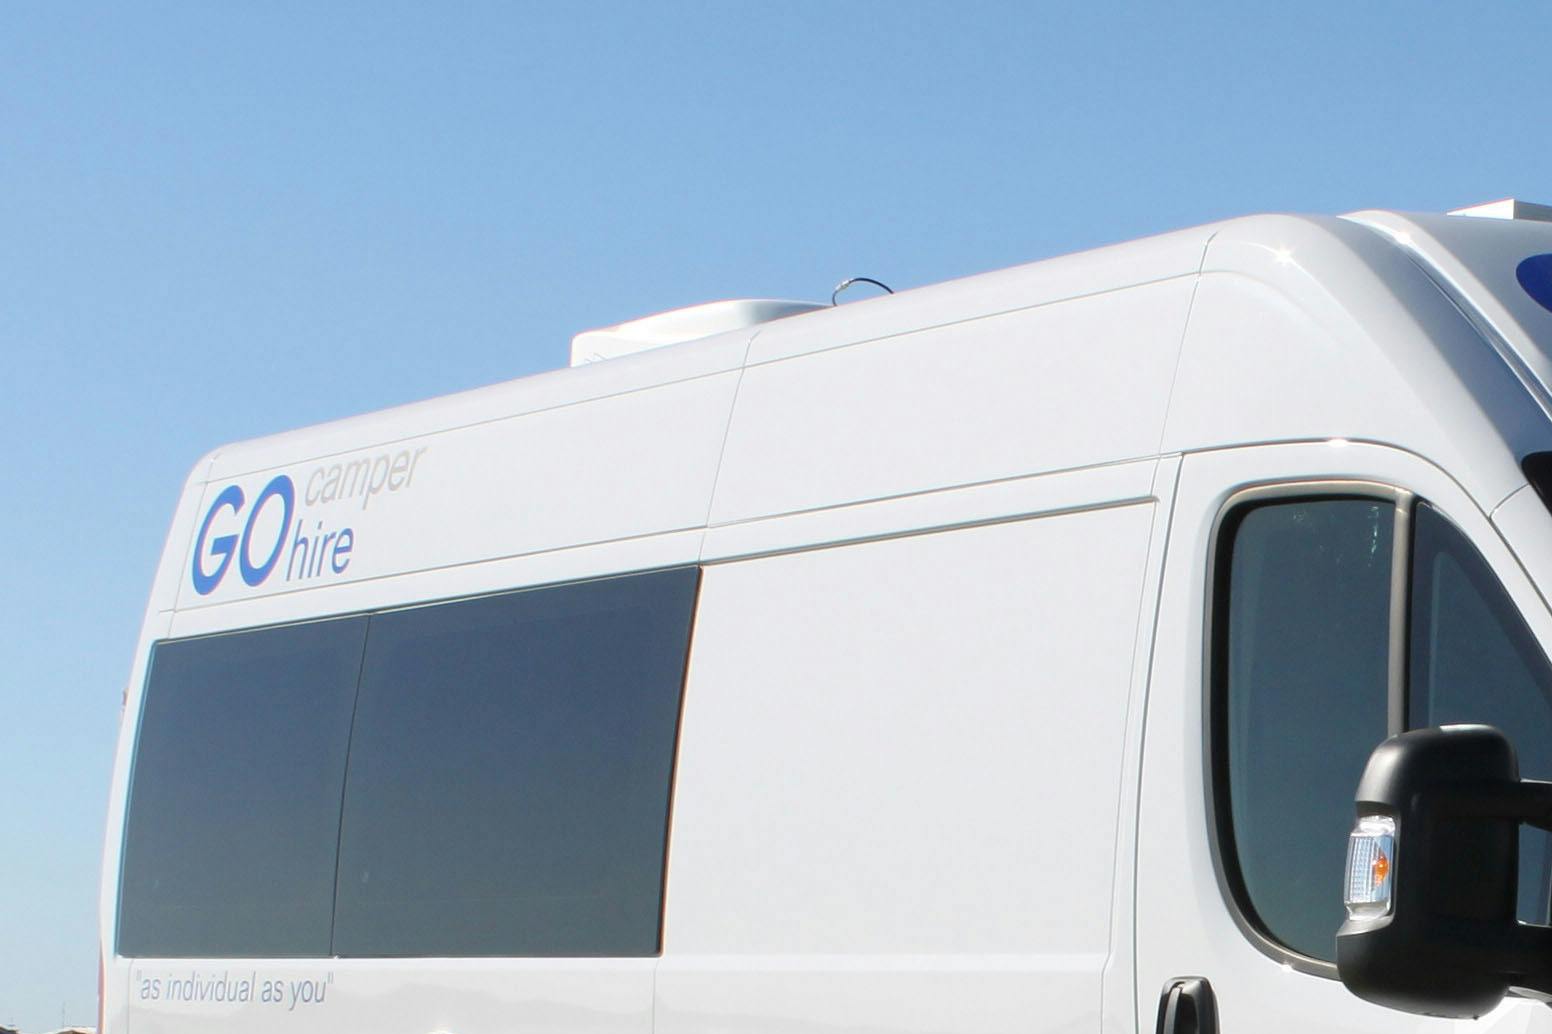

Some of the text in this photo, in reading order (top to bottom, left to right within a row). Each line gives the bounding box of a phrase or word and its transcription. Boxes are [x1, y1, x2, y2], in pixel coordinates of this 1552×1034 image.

[304, 446, 427, 510] camper
[192, 475, 295, 595] GO
[286, 519, 354, 581] hire
[166, 971, 256, 1001] individual
[261, 980, 283, 1002] as
